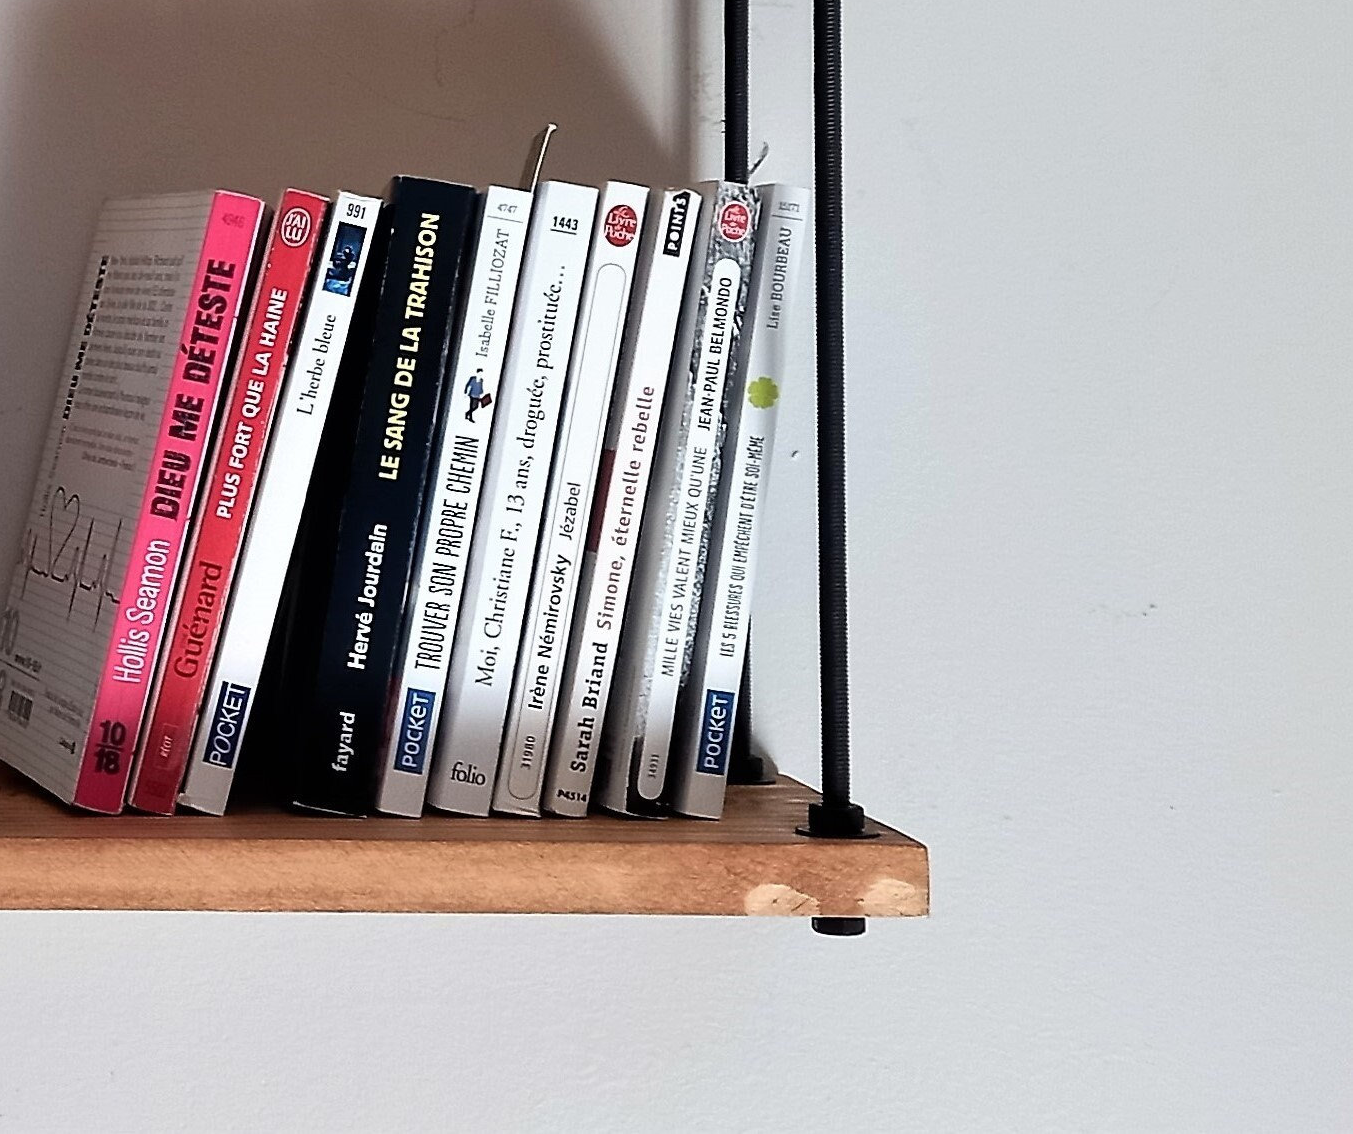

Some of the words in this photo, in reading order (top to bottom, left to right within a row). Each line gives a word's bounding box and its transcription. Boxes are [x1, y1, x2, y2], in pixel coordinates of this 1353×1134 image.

[346, 203, 366, 220] 991
[552, 216, 579, 231] 1443
[608, 212, 637, 228] Livre
[667, 196, 687, 252] POINTS
[405, 213, 441, 319] TRAHISON
[484, 228, 510, 306] FILLIOZAT
[771, 227, 793, 302] BOURBEAU
[180, 259, 236, 385] DÉTESTE
[259, 287, 288, 347] HAINE
[399, 327, 422, 353] LA
[475, 309, 496, 358] Isabelle
[708, 277, 733, 355] BELMONDO
[766, 305, 782, 330] Lise
[254, 352, 272, 377] LA
[297, 356, 325, 416] L'herbe
[313, 314, 337, 354] bleue
[394, 357, 416, 388] DE
[168, 393, 205, 442] ME
[242, 380, 265, 419] QUE
[383, 393, 411, 451] SANG
[516, 375, 549, 450] droguée,
[631, 385, 655, 453] rebelle
[697, 358, 721, 432] JEAN-PAUL
[228, 421, 254, 470] FORT
[378, 454, 401, 481] LE
[446, 435, 479, 495] CHEMIN
[515, 456, 535, 490] ans,
[688, 446, 708, 500] QU'UNE
[150, 450, 191, 522] DIEU
[216, 472, 241, 519] PLUS
[506, 494, 525, 514] 13
[559, 481, 582, 541] Jézabel
[611, 459, 642, 547] éternelle
[435, 499, 469, 558] PROPRE
[681, 501, 699, 546] MIEUX
[126, 538, 171, 625] Seamon
[358, 523, 388, 608] Jourdain
[428, 562, 457, 597] SON
[483, 547, 515, 640] Christiane
[597, 555, 626, 631] Simone,
[674, 550, 692, 600] VALENT
[731, 563, 747, 581] QUI
[174, 560, 224, 679] Guénard
[537, 554, 572, 659] Némirovsky
[668, 602, 684, 637] VIES
[112, 629, 151, 684] Hollis
[347, 612, 374, 670] Hervé
[415, 600, 451, 670] TROUVER
[661, 638, 679, 677] MILLE
[475, 646, 501, 687] Moi,
[528, 664, 550, 710] Irène
[582, 641, 609, 710] Briand
[99, 719, 127, 747] 10
[209, 682, 247, 766] POCKET
[332, 711, 356, 772] fayard
[569, 716, 596, 774] Sarah
[93, 748, 120, 775] 18
[450, 761, 487, 786] folio
